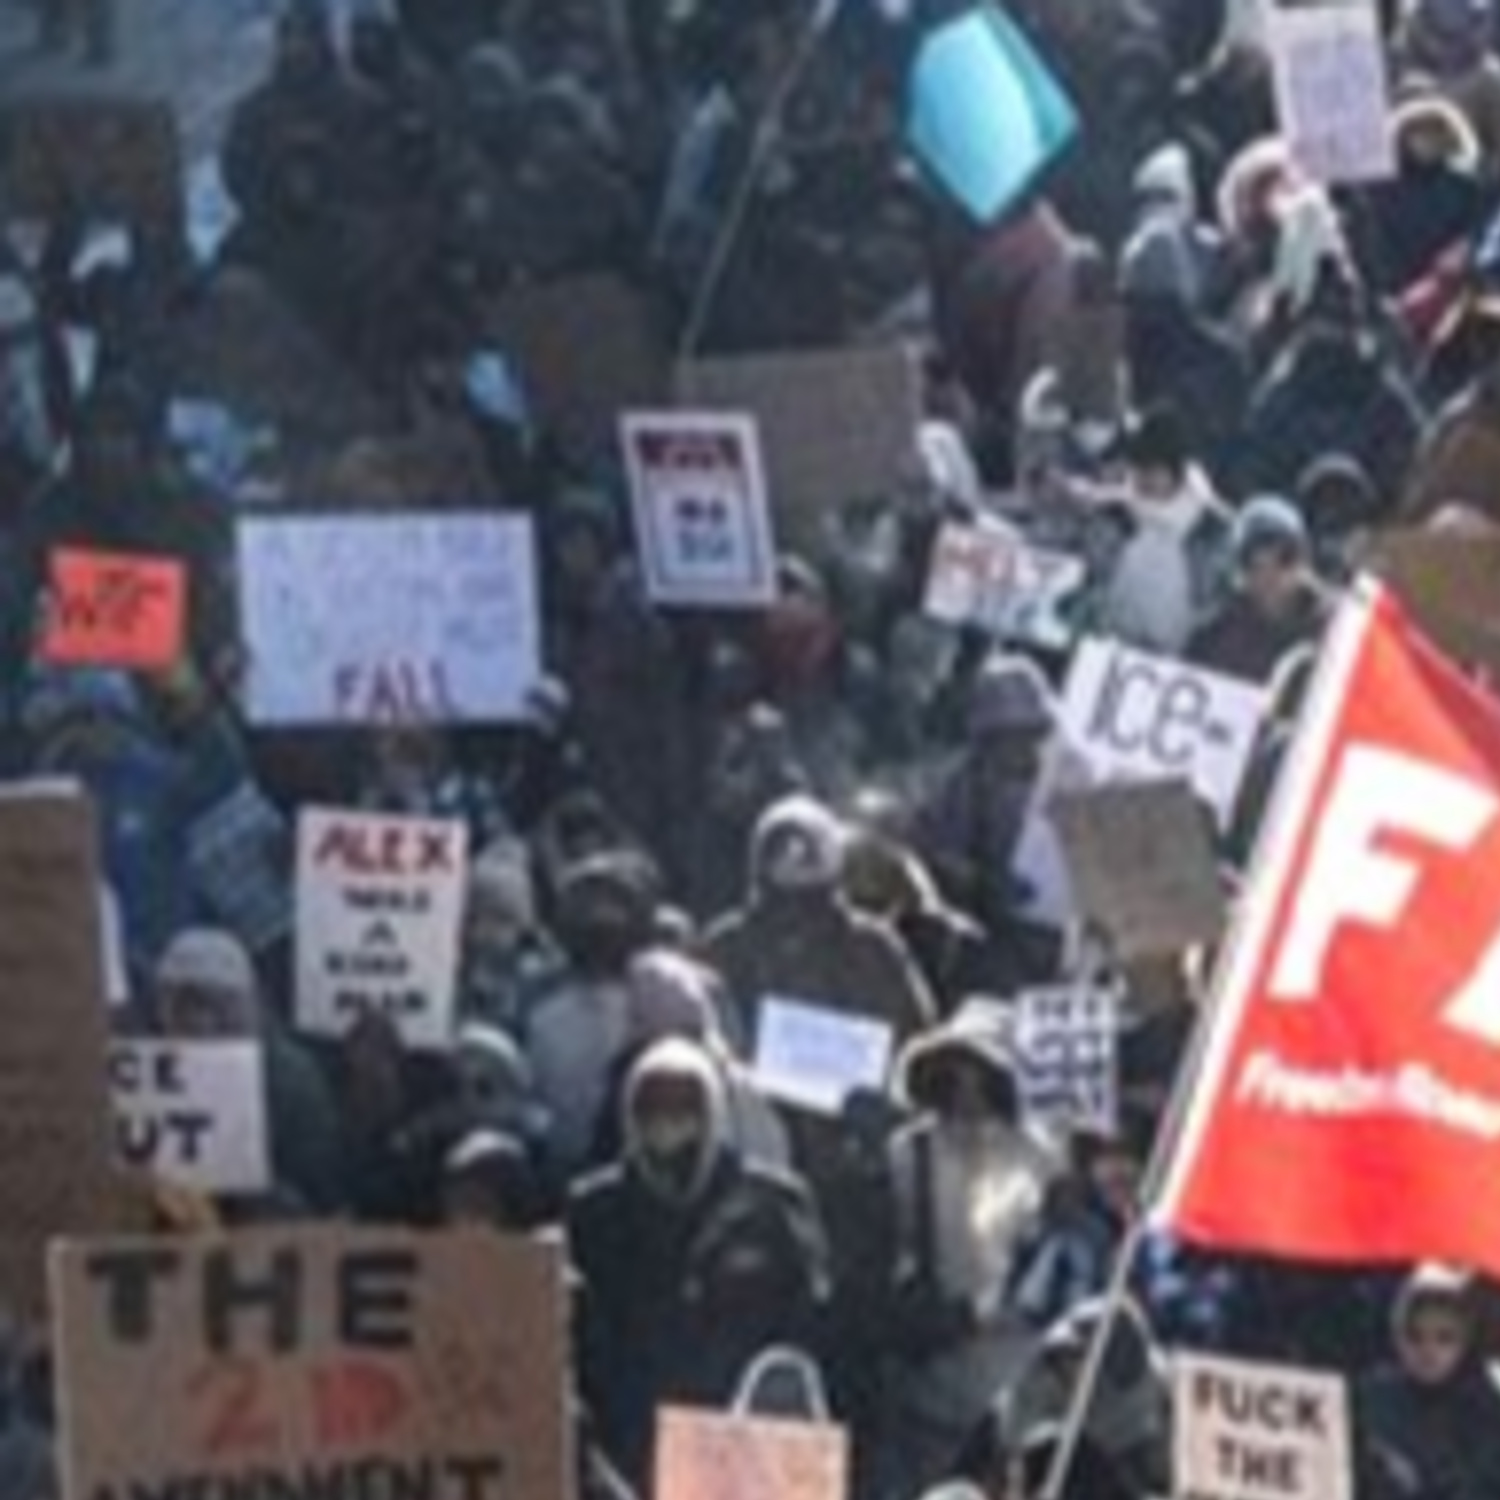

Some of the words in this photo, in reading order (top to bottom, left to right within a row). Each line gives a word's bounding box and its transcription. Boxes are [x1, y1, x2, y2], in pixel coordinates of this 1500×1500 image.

[314, 821, 455, 875] ALEX
[109, 1048, 187, 1094] CE
[119, 1114, 215, 1166] UT
[85, 1250, 417, 1355] THE
[1195, 1372, 1327, 1441] FUCK
[1217, 1435, 1303, 1493] THE
